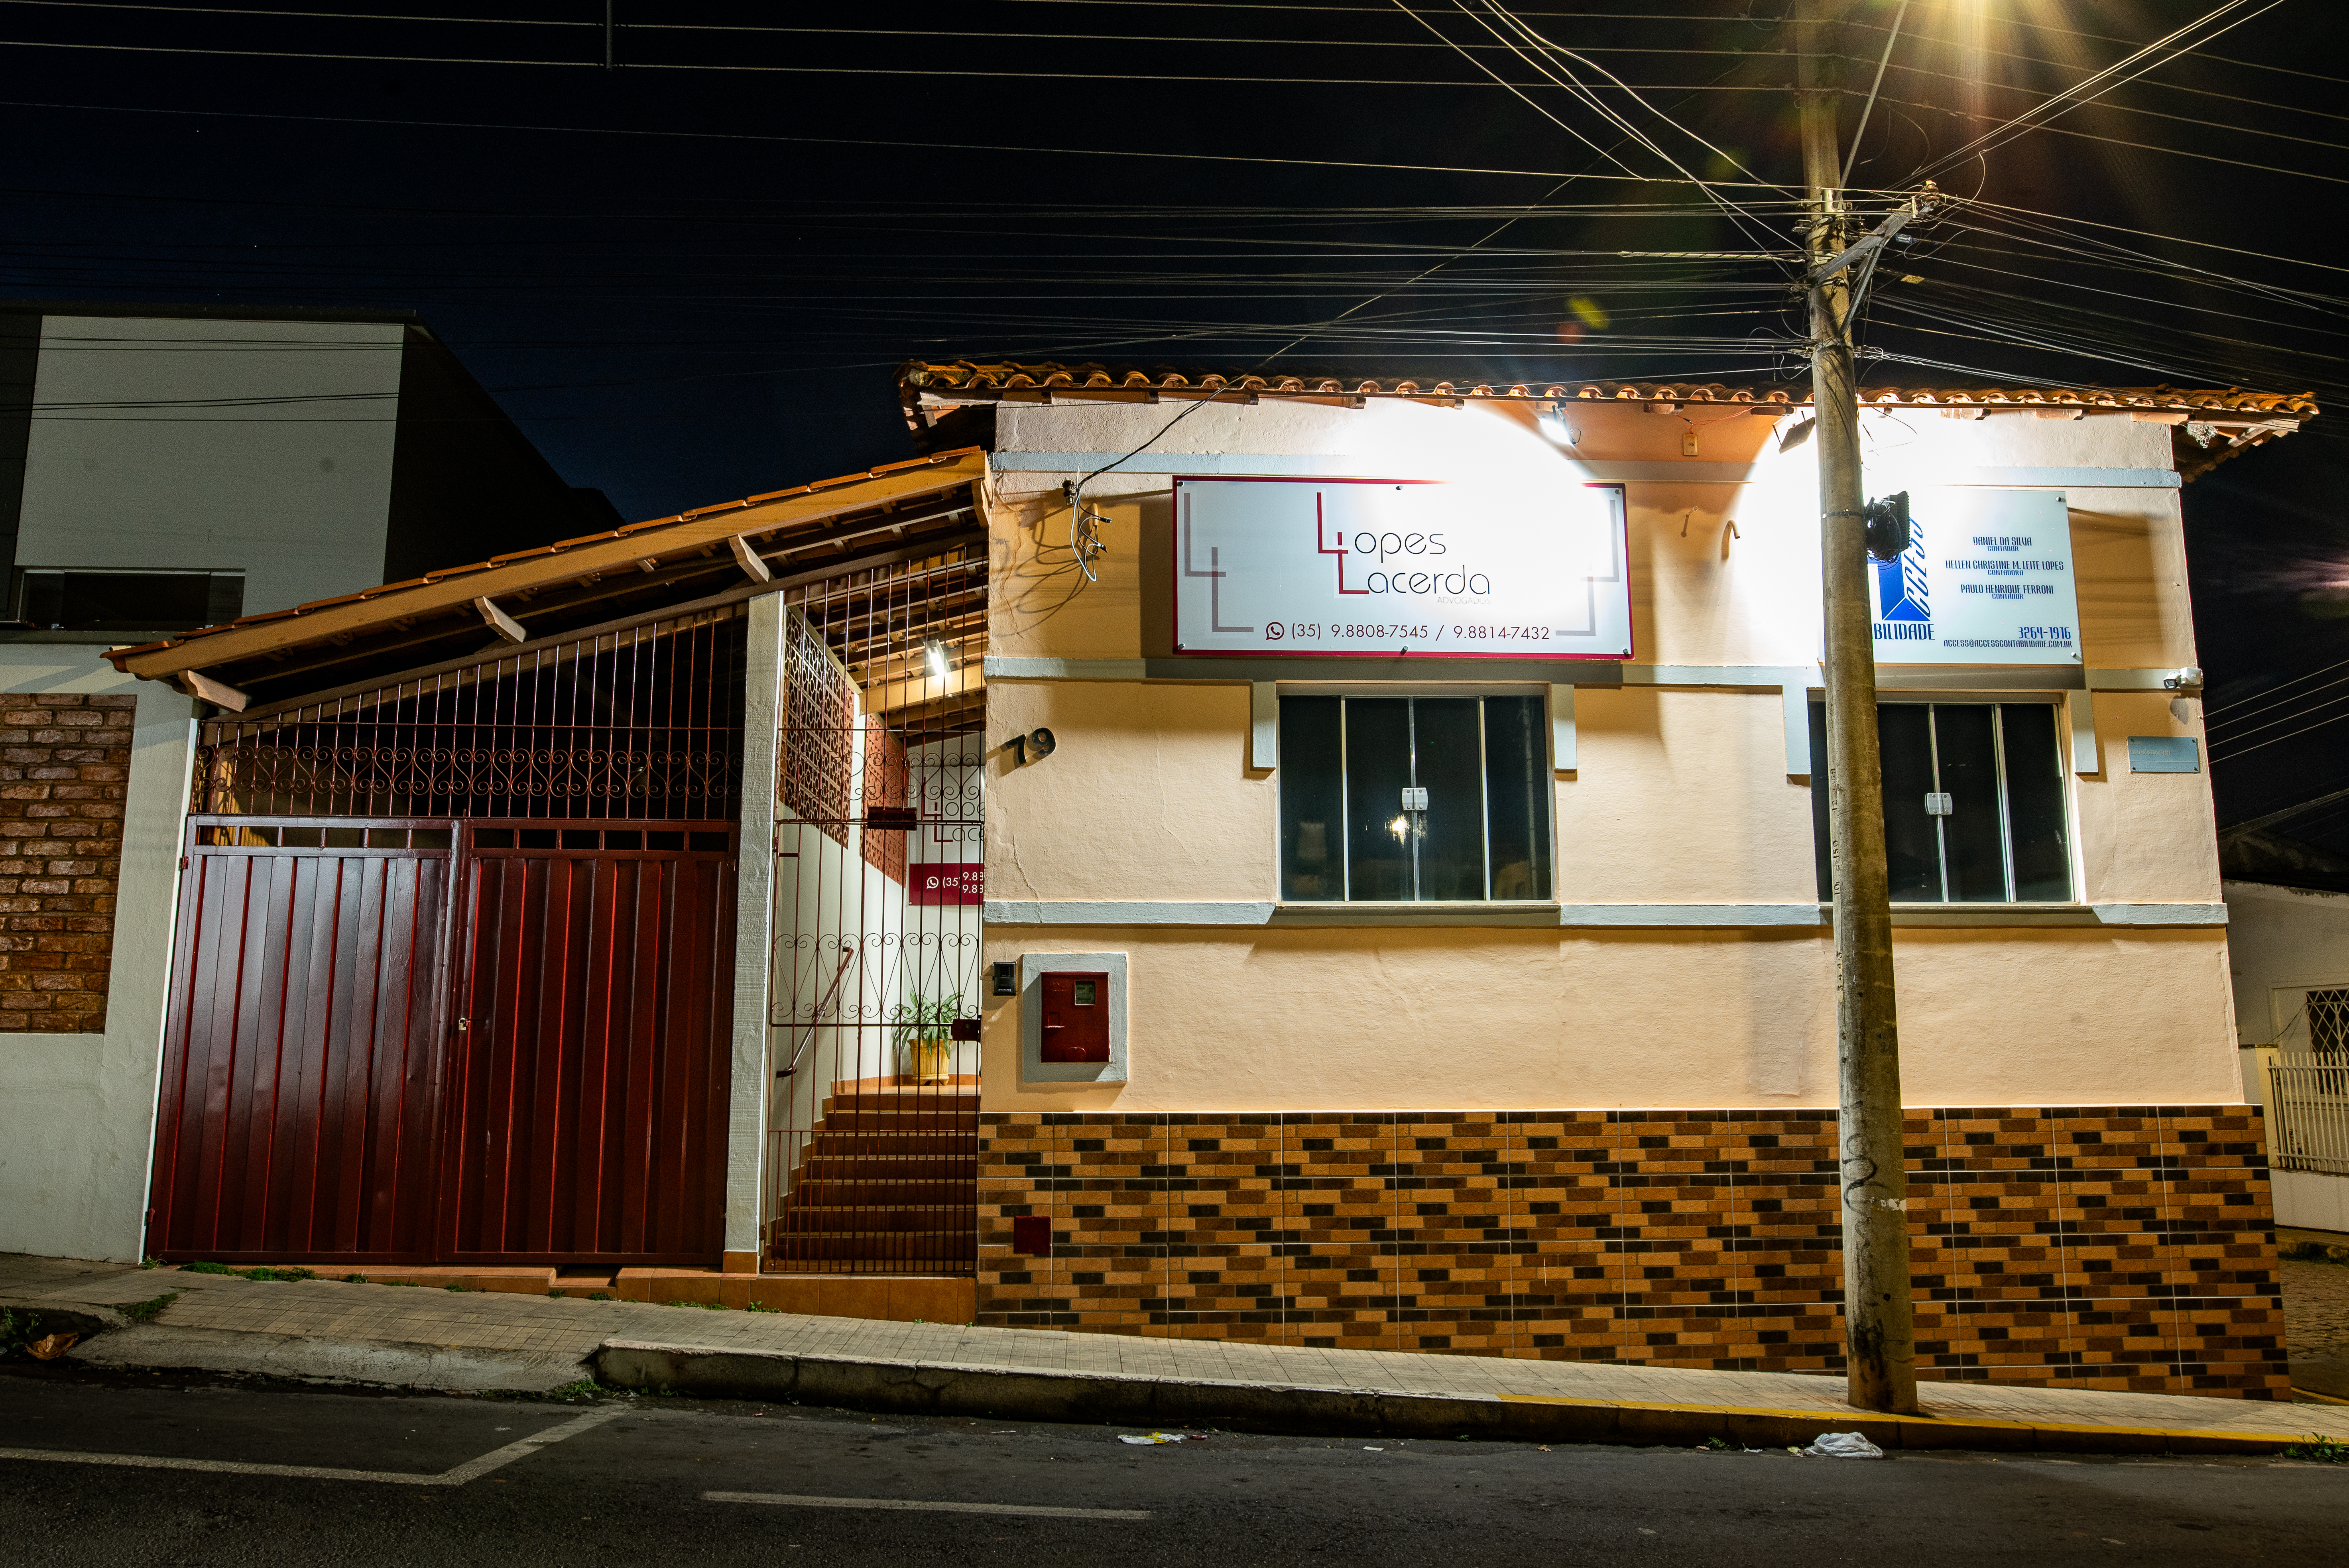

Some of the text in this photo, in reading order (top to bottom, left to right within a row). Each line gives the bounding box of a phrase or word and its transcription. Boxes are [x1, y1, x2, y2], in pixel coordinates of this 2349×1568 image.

[1316, 492, 1446, 563] Lopes
[1973, 537, 2032, 546] DANIEL DA SILVA
[1337, 532, 1490, 594] Lacerda
[1946, 560, 2064, 570] HELLEN CHRISTINE M. LEITE LOPES
[1961, 584, 2054, 594] PAULO HENRIQUE FERRONI
[1292, 623, 1549, 641] (35) 9.8808-7545 / 9.8814-7432
[2018, 626, 2071, 639] 3264-1916
[1944, 639, 2073, 648] ACCESS@ACCESSCONTABILIDADE.COM.BR
[1005, 727, 1056, 765] 79
